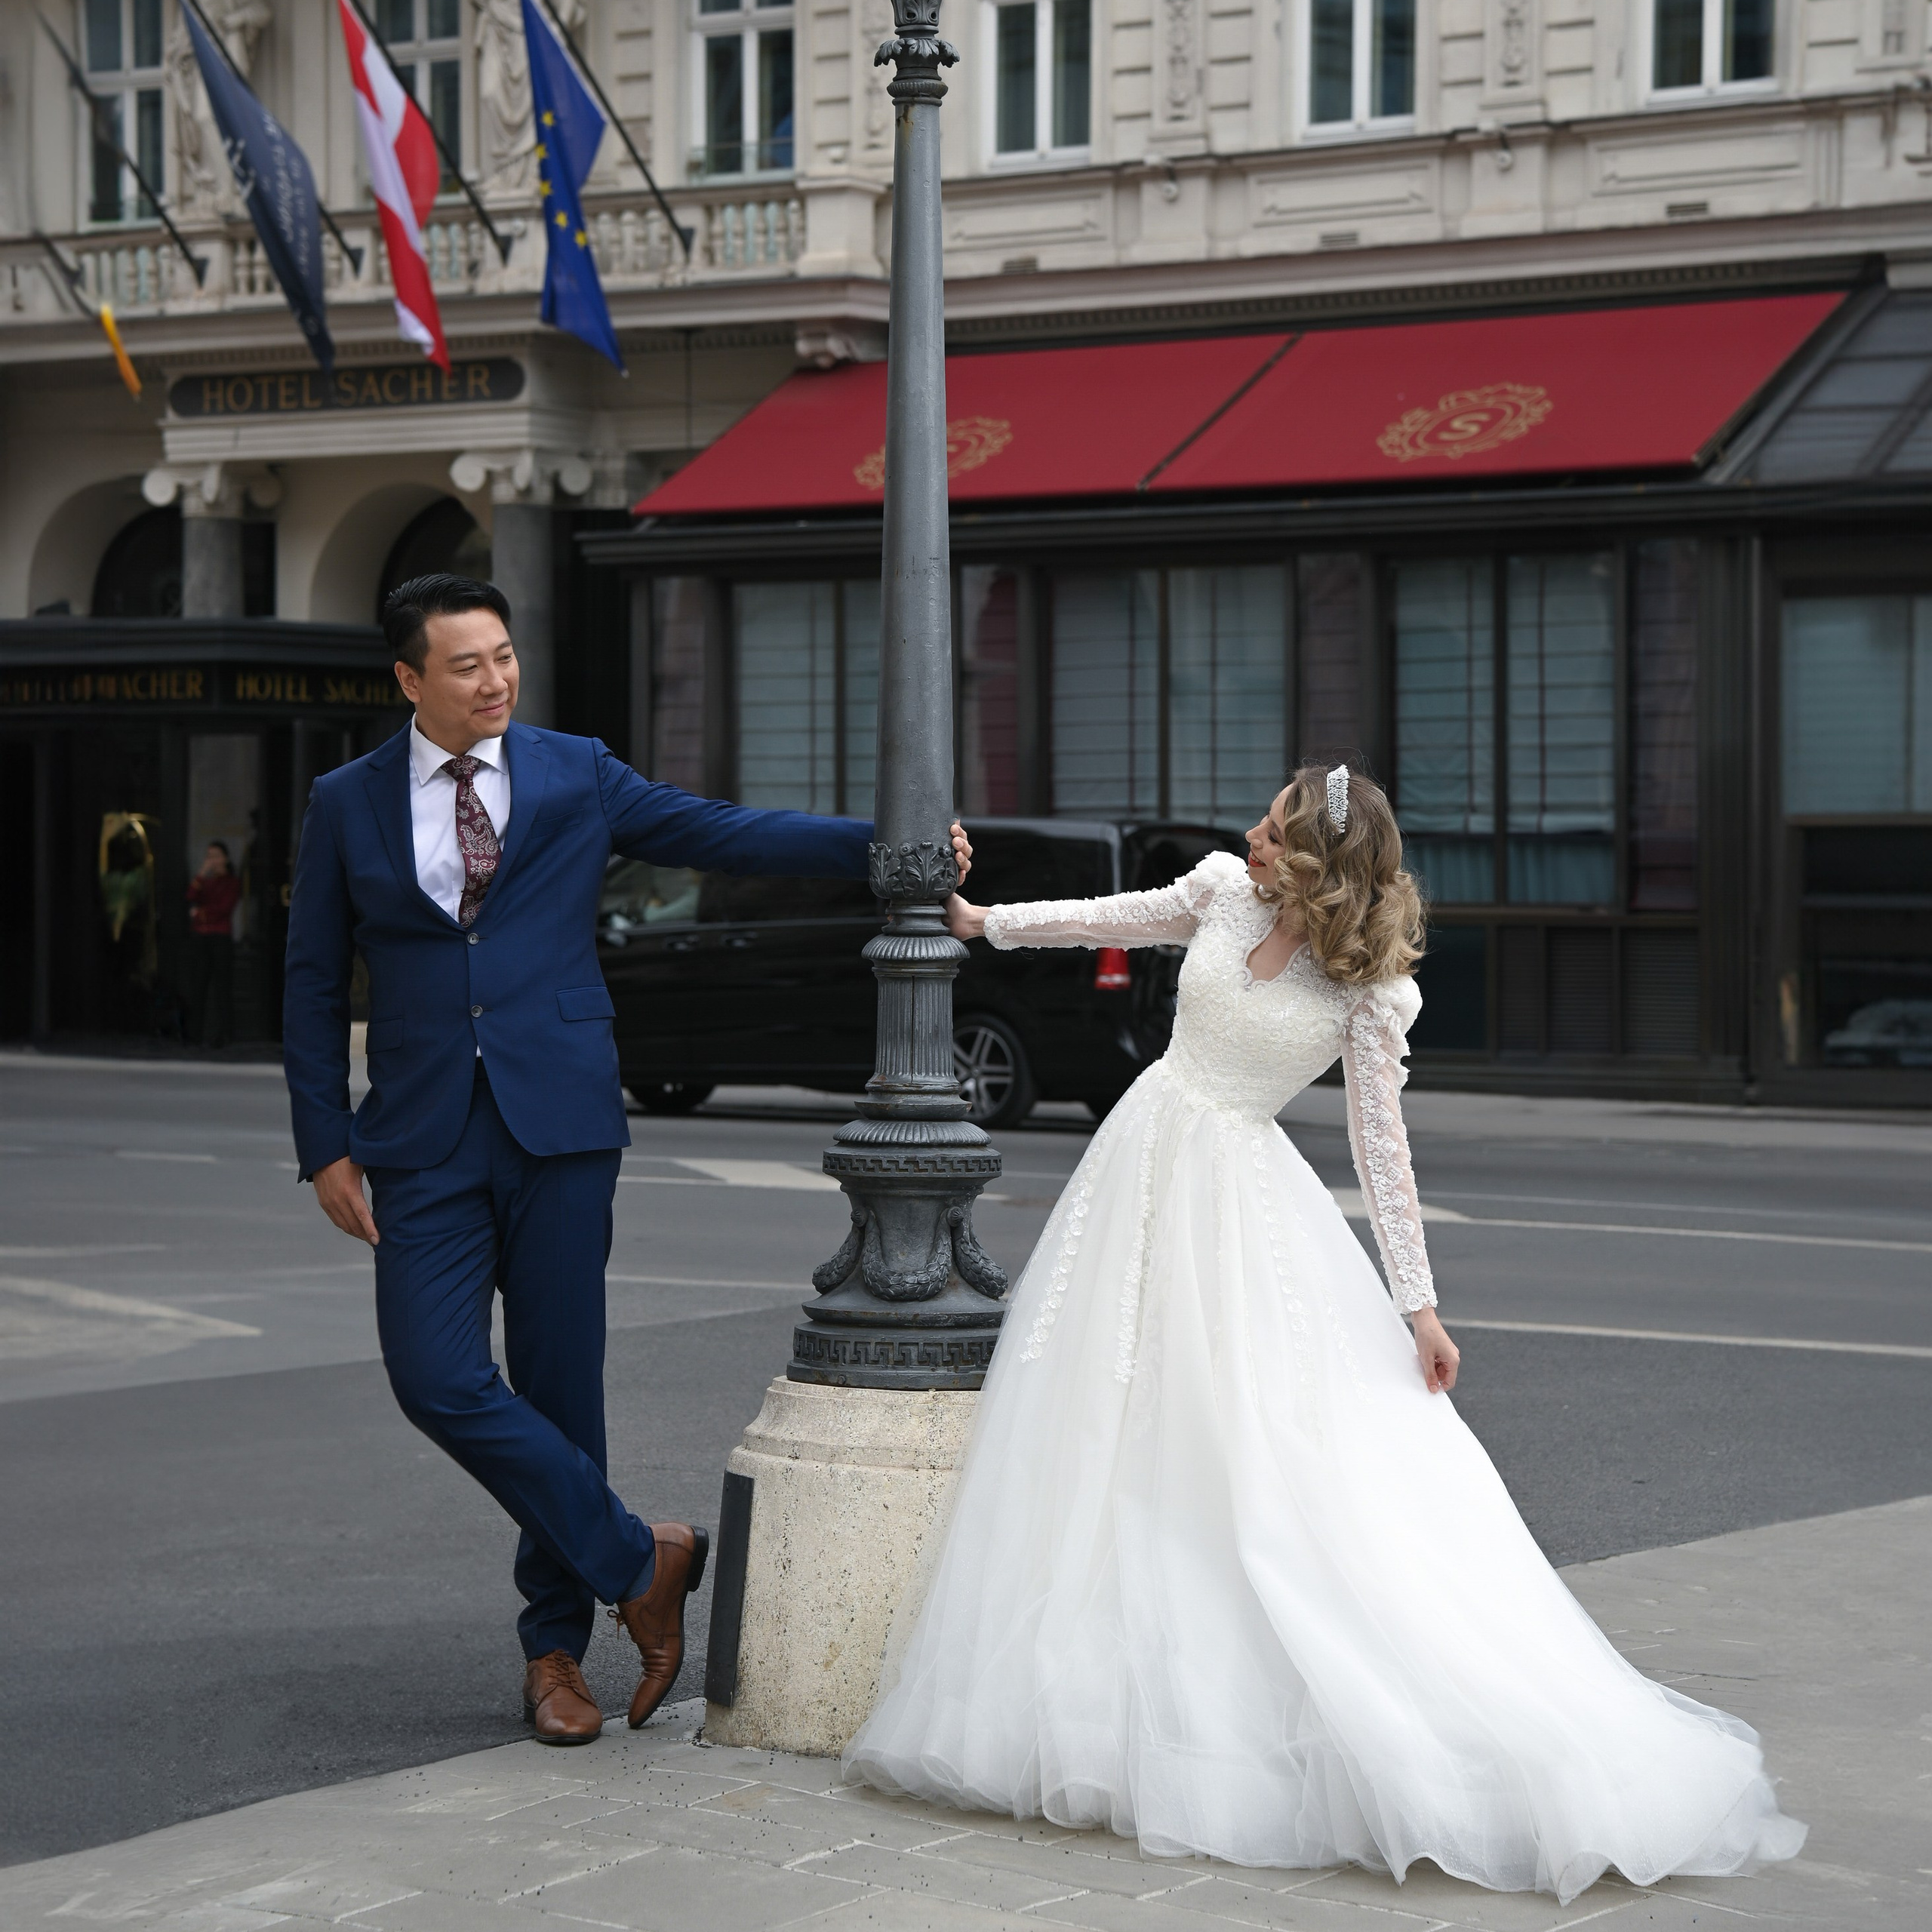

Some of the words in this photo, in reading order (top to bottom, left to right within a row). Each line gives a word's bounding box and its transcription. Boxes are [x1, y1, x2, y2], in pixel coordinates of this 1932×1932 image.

[202, 372, 323, 414] HOTEL
[339, 362, 492, 408] SACHER
[235, 672, 314, 703] HOTEL
